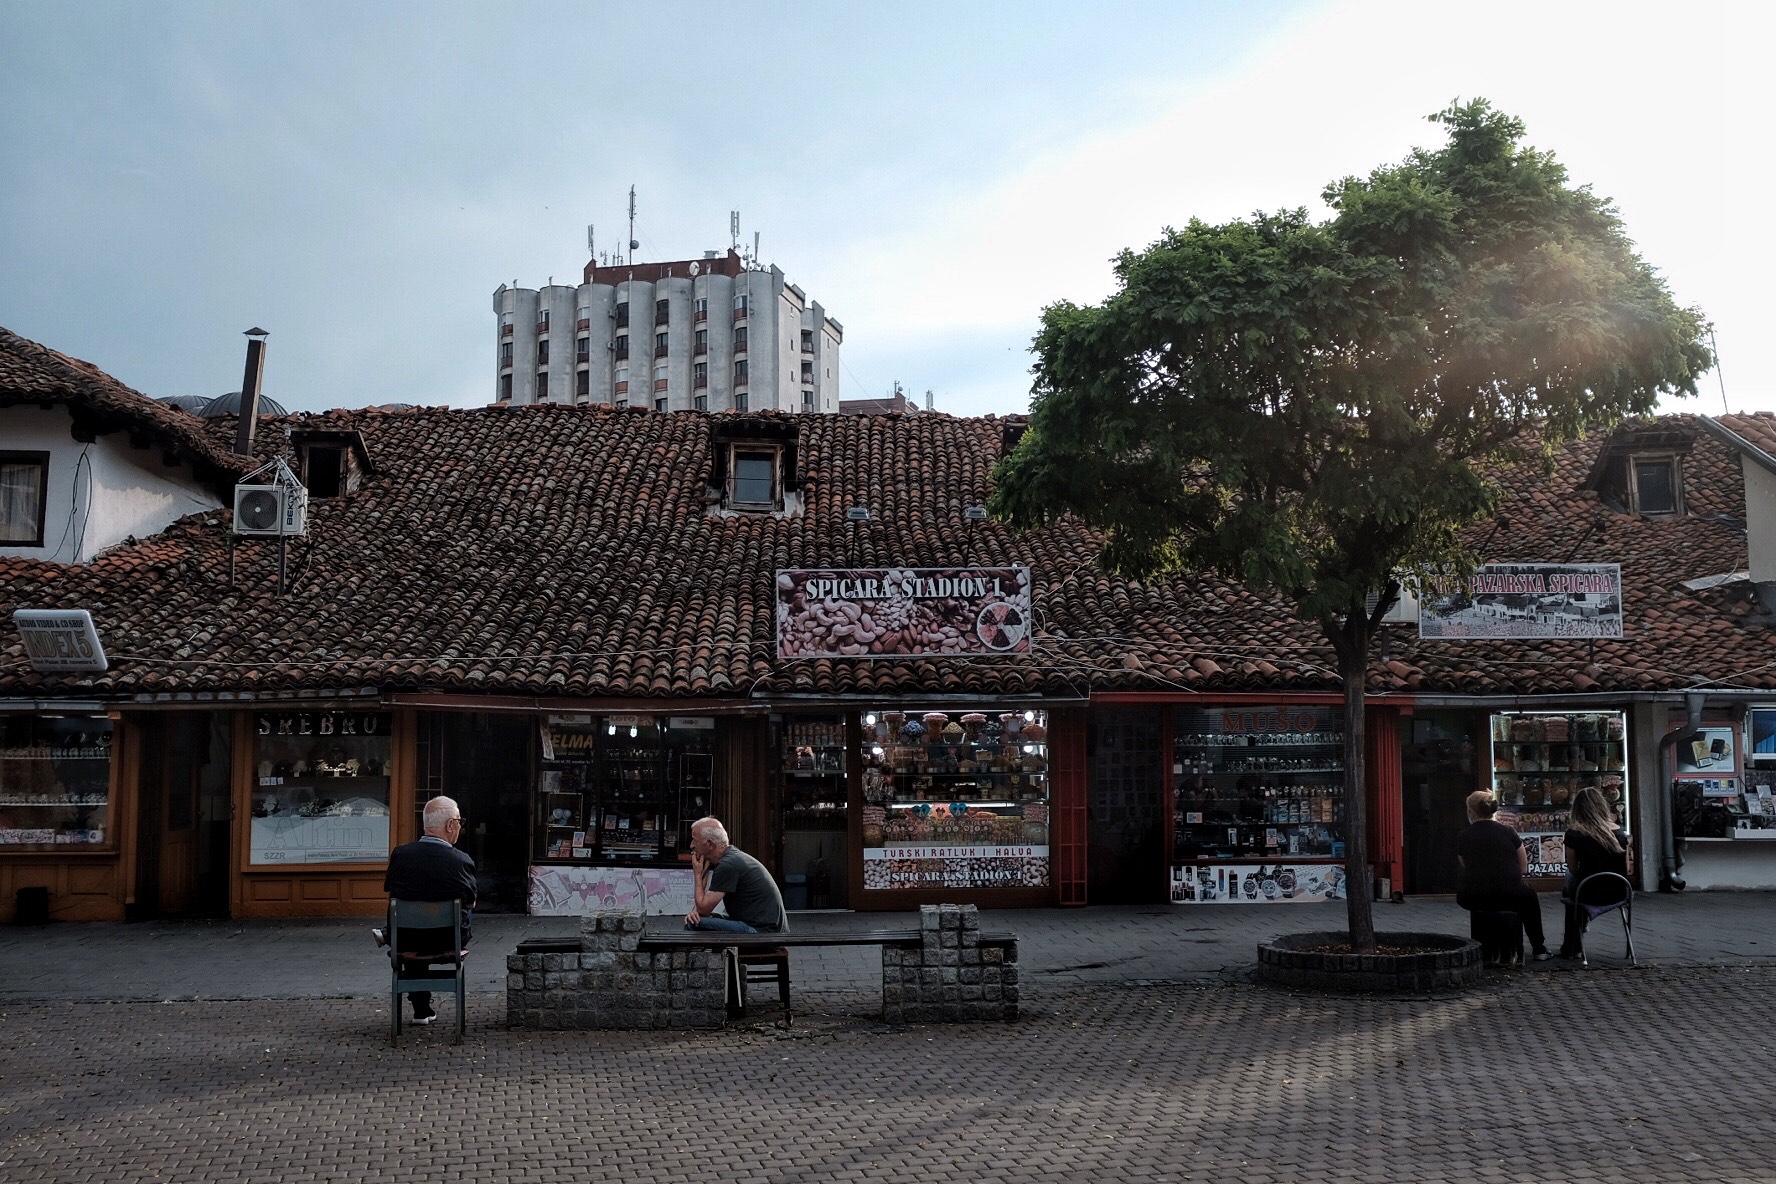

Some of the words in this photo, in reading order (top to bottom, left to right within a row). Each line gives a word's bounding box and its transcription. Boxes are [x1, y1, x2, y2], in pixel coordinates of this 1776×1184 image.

[805, 578, 893, 600] SPICARA
[901, 577, 988, 599] STADION
[992, 577, 1003, 597] 1
[1469, 573, 1547, 594] PAZARSKA
[1549, 573, 1614, 594] SPICARA
[18, 619, 37, 628] AUDIO
[36, 619, 55, 628] VIDEO
[61, 619, 69, 628] CD
[69, 619, 84, 628] SHOP
[258, 712, 378, 735] SREBRO
[1222, 706, 1316, 733] MUŠO
[551, 734, 594, 749] ELMA
[266, 816, 375, 848] Altin
[263, 852, 286, 860] SZZR
[882, 849, 926, 859] TURSKI
[931, 848, 976, 857] RATLUK
[1528, 863, 1568, 873] PAZARS
[891, 871, 951, 882] SPICARA
[955, 870, 1013, 881] STADION
